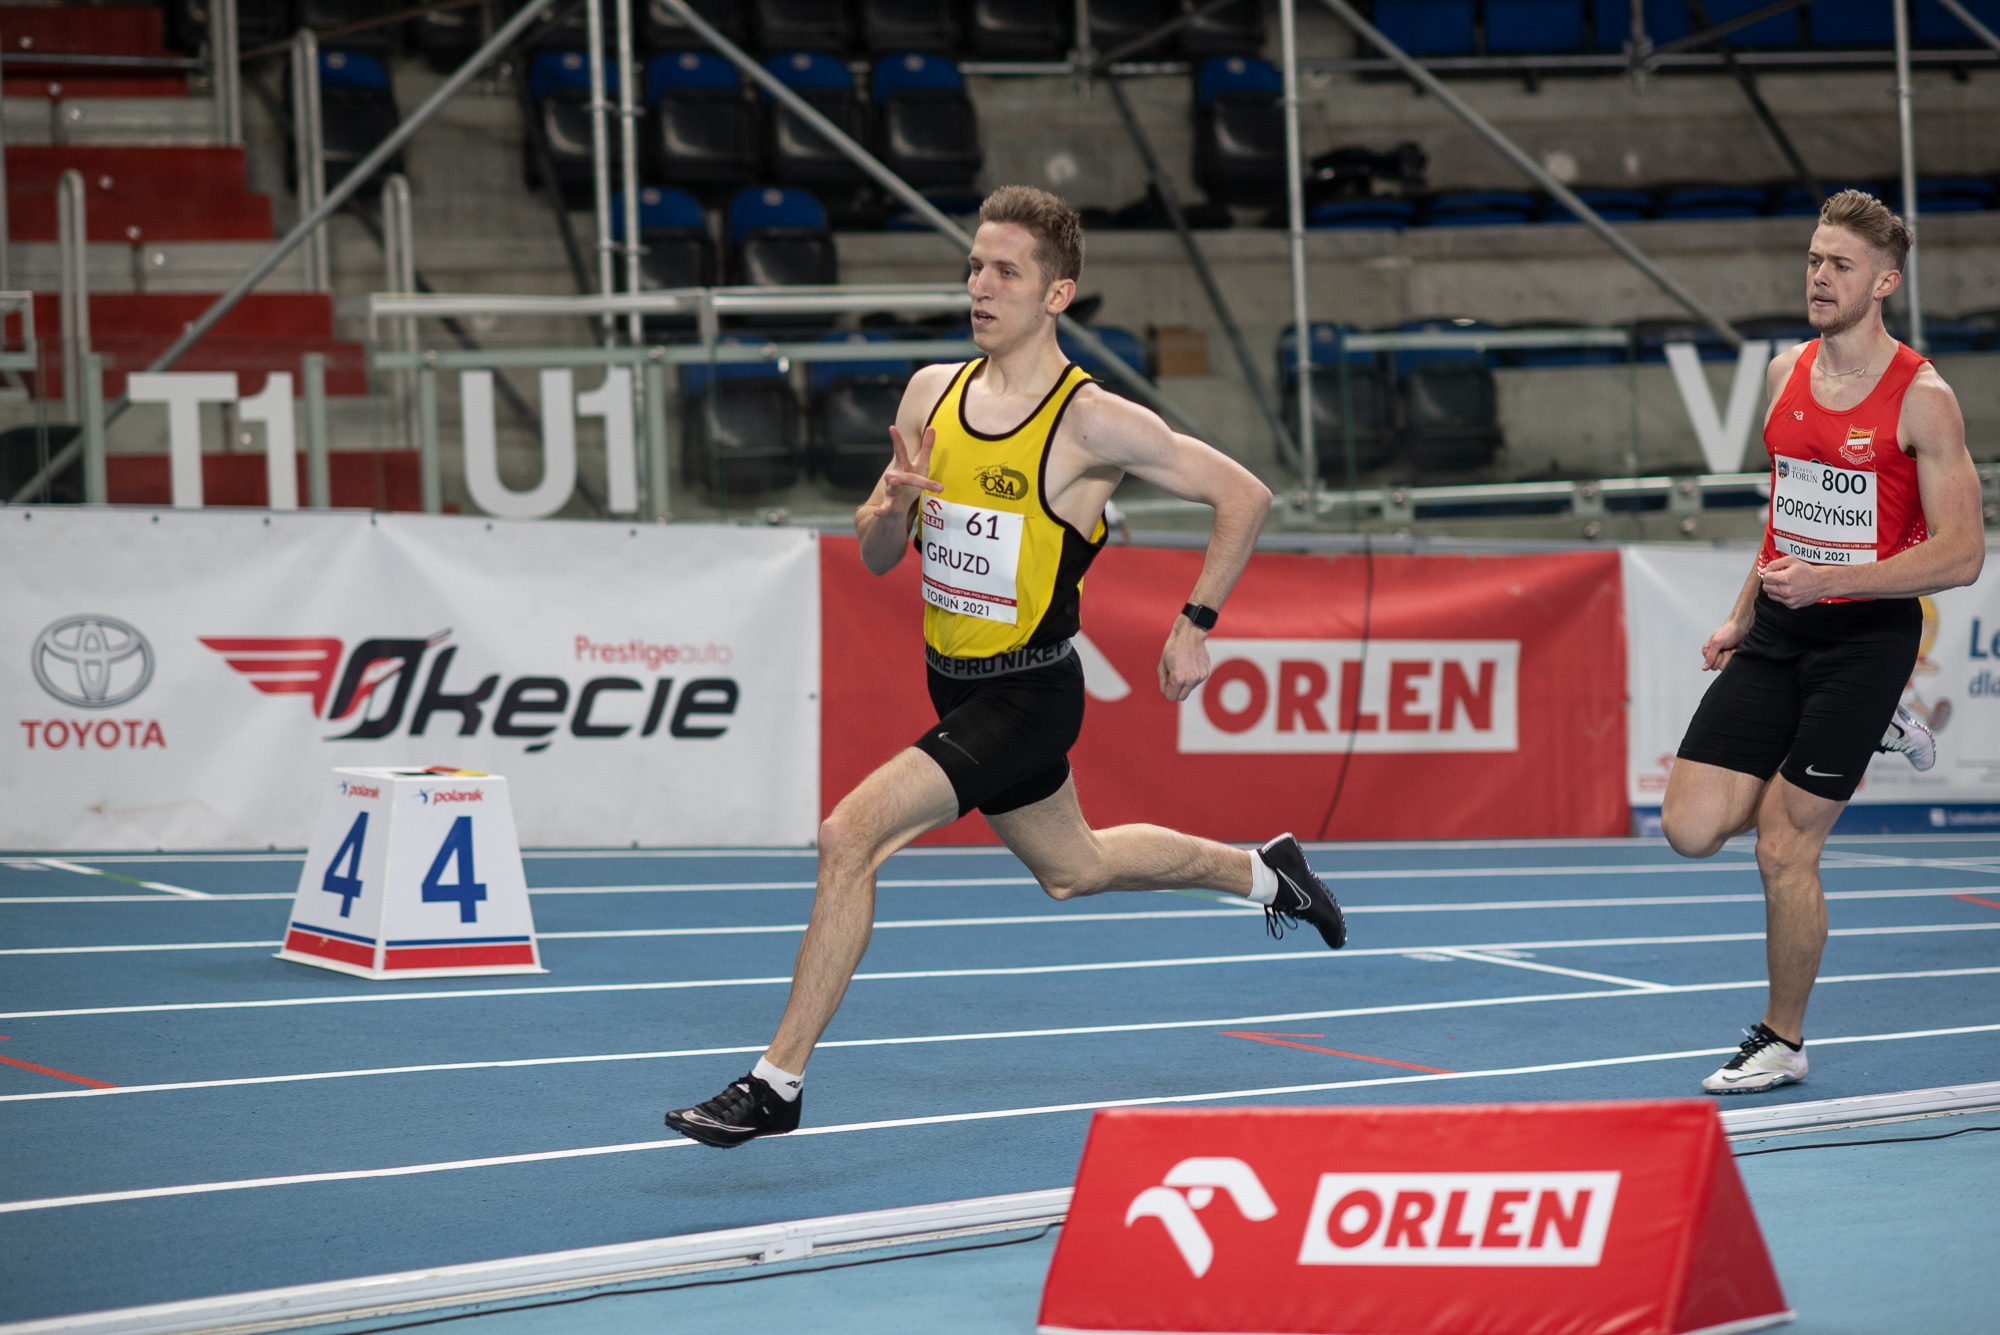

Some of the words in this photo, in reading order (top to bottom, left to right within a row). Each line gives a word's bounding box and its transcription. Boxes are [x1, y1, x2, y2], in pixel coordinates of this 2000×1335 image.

[1664, 339, 1803, 474] V
[127, 371, 299, 511] T1
[460, 367, 638, 518] U1
[984, 476, 1016, 496] OSA
[1791, 470, 1818, 484] TORUŃ
[1792, 466, 1813, 475] MIASTO
[1822, 469, 1867, 495] 800
[966, 512, 1000, 541] 61
[1776, 495, 1872, 527] POROŻYŃSKI
[926, 541, 990, 576] GRUZD
[1789, 543, 1821, 560] TORUŃ
[1824, 551, 1850, 562] 2021
[926, 587, 958, 610] TORUŃ
[962, 601, 990, 617] 2021
[574, 634, 735, 671] Prestigeauto
[925, 643, 952, 674] NIKE
[954, 657, 996, 676] PRO
[1001, 648, 1054, 671] NIKE
[1202, 655, 1498, 736] ORLEN
[21, 719, 167, 750] TOYOTA
[348, 783, 380, 799] polanik
[432, 788, 484, 806] polanik
[321, 810, 370, 919] 4
[421, 815, 488, 924] 4
[1325, 1187, 1595, 1251] ORLEN
